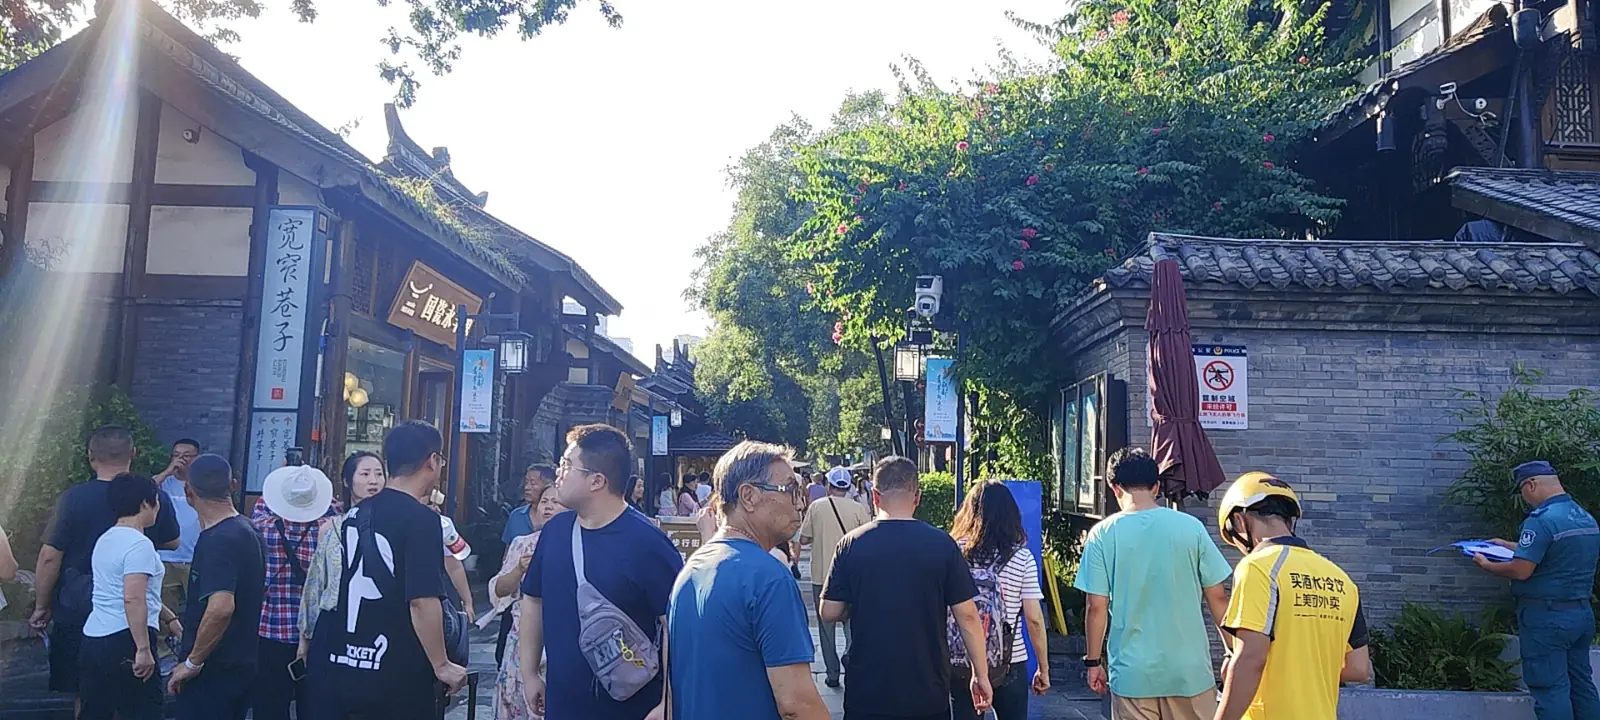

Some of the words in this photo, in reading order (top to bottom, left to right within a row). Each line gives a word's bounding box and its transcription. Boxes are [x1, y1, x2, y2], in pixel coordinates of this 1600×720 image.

[270, 217, 303, 352] 宽窄巷子
[281, 428, 292, 456] 宽巷
[1289, 572, 1346, 595] 买酒水冷饮
[1293, 592, 1341, 611] 上美团外卖
